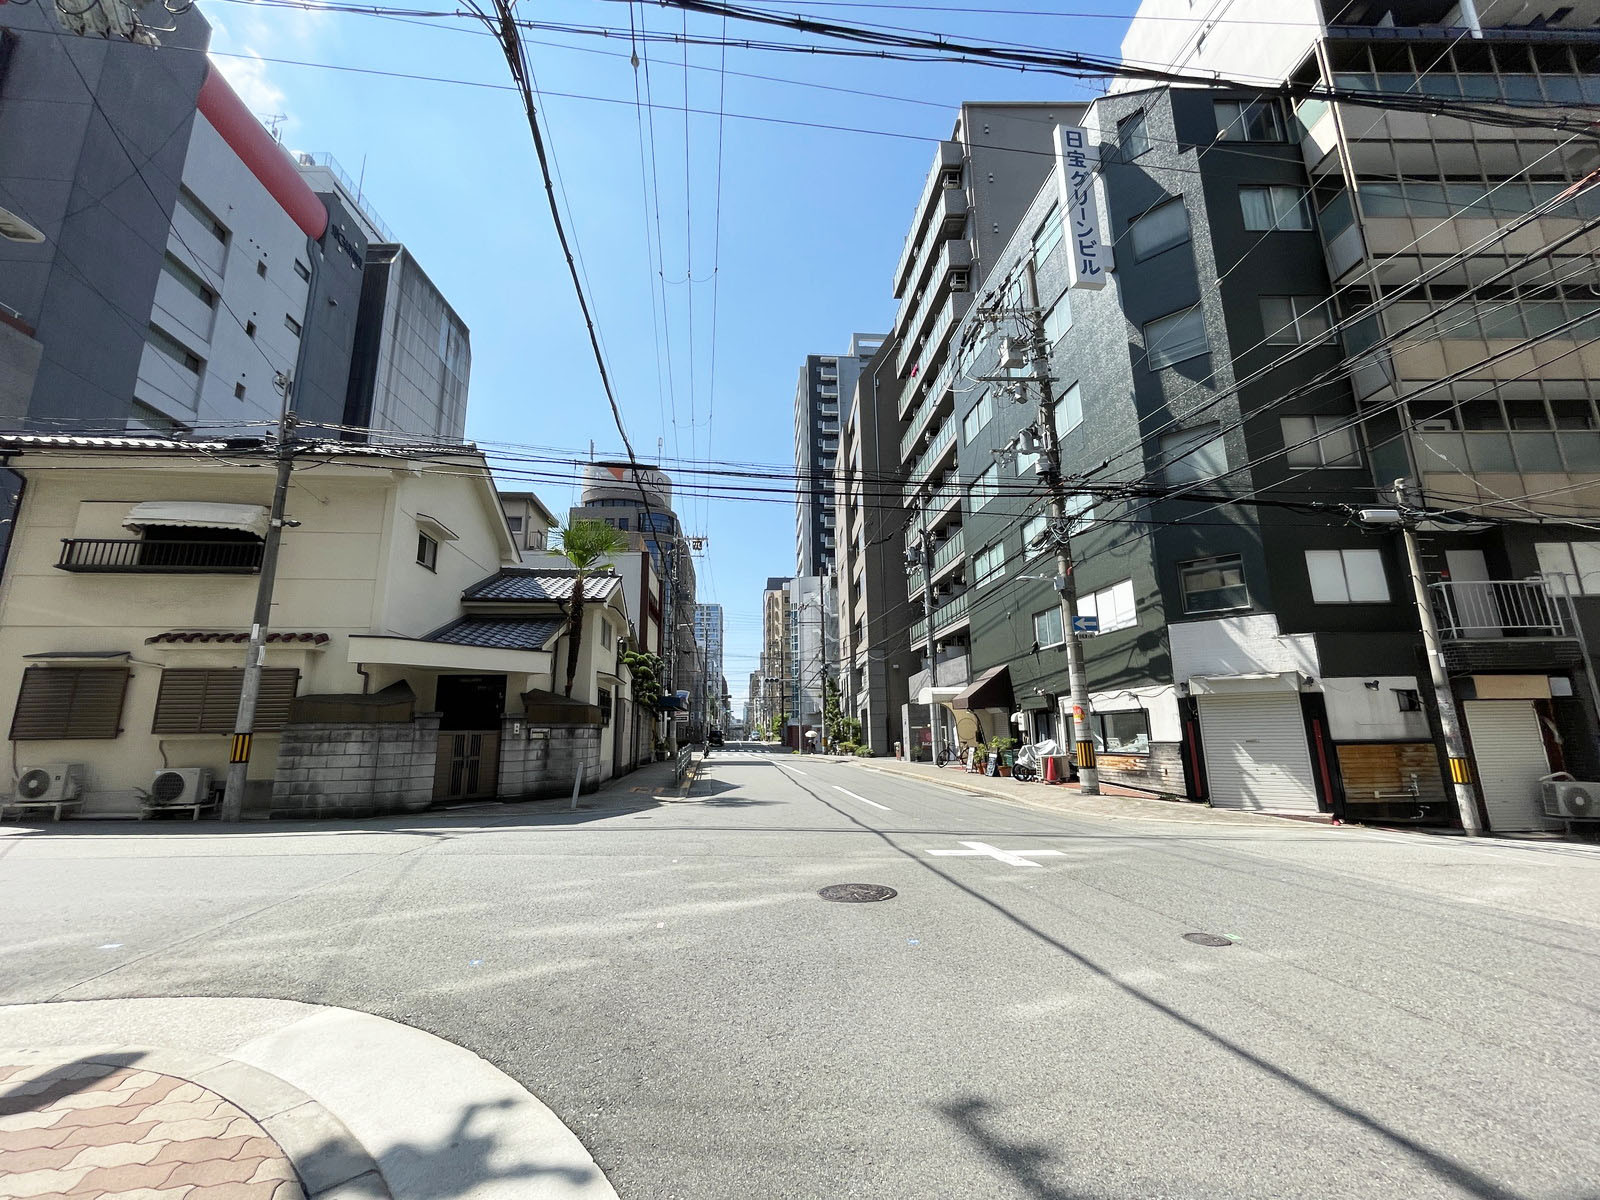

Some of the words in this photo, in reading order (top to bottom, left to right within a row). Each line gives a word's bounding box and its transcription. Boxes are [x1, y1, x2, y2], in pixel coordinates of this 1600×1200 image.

[1066, 131, 1101, 275] 日宝グリーンビル
